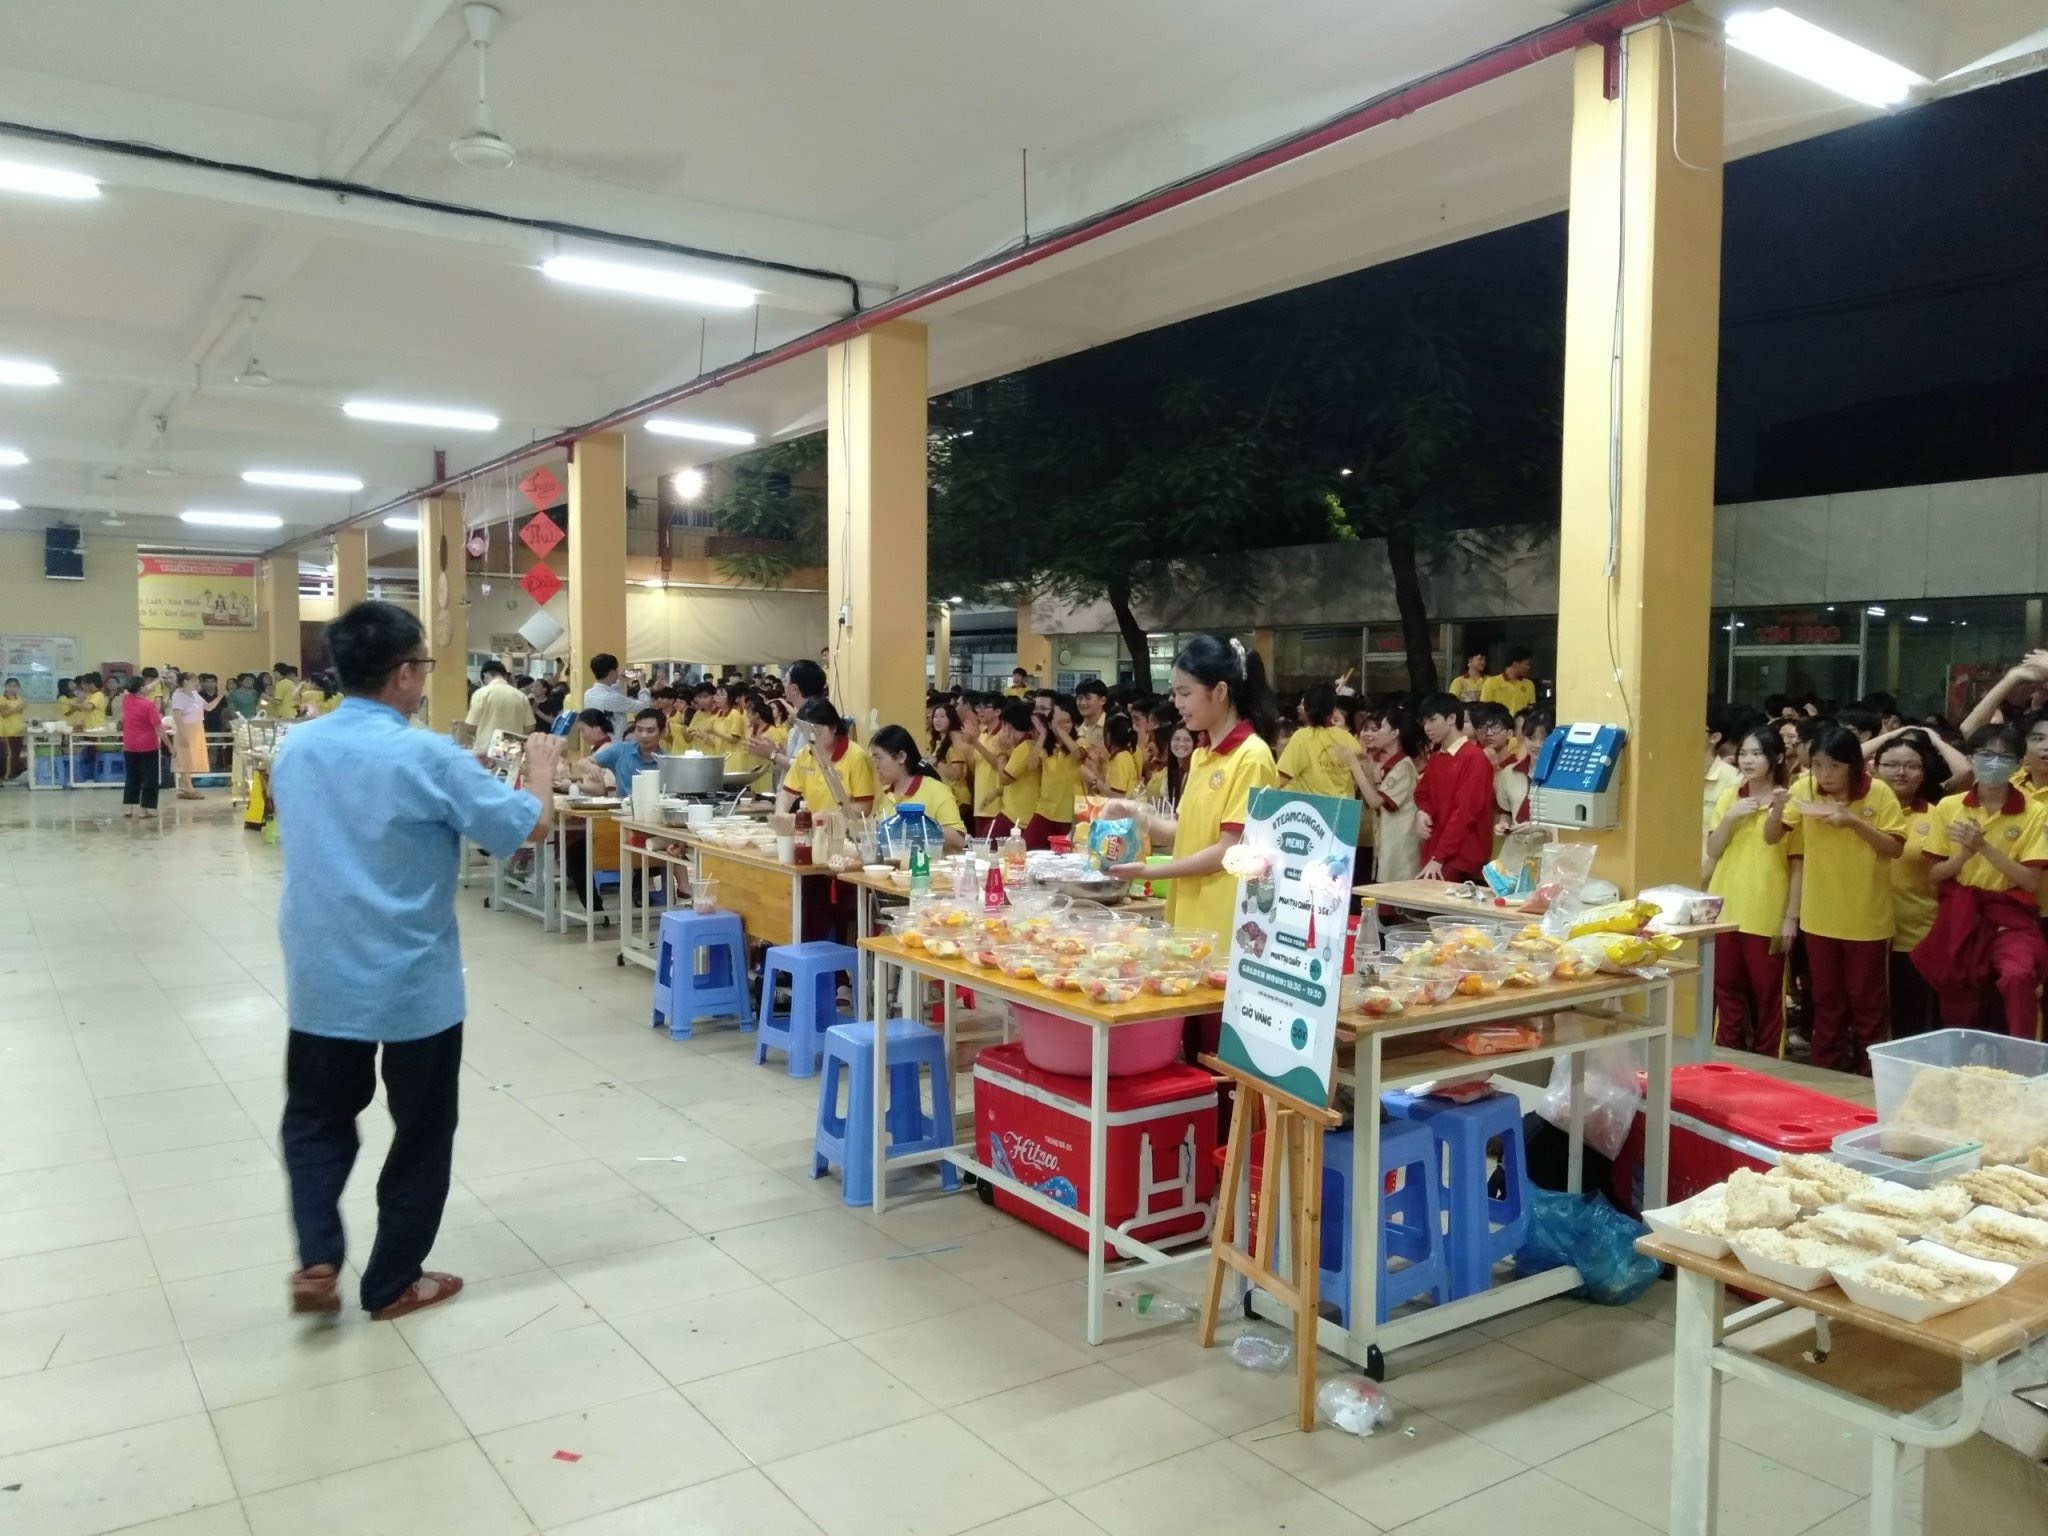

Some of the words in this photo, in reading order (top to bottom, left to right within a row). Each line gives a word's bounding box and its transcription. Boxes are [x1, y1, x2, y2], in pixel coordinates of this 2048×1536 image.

[1272, 811, 1325, 841] #TEAMCONGAN
[1285, 838, 1305, 850] MENU
[1241, 964, 1266, 979] GOLDEN
[1241, 1003, 1253, 1018] GIỜ
[1254, 1008, 1272, 1027] VÀNG
